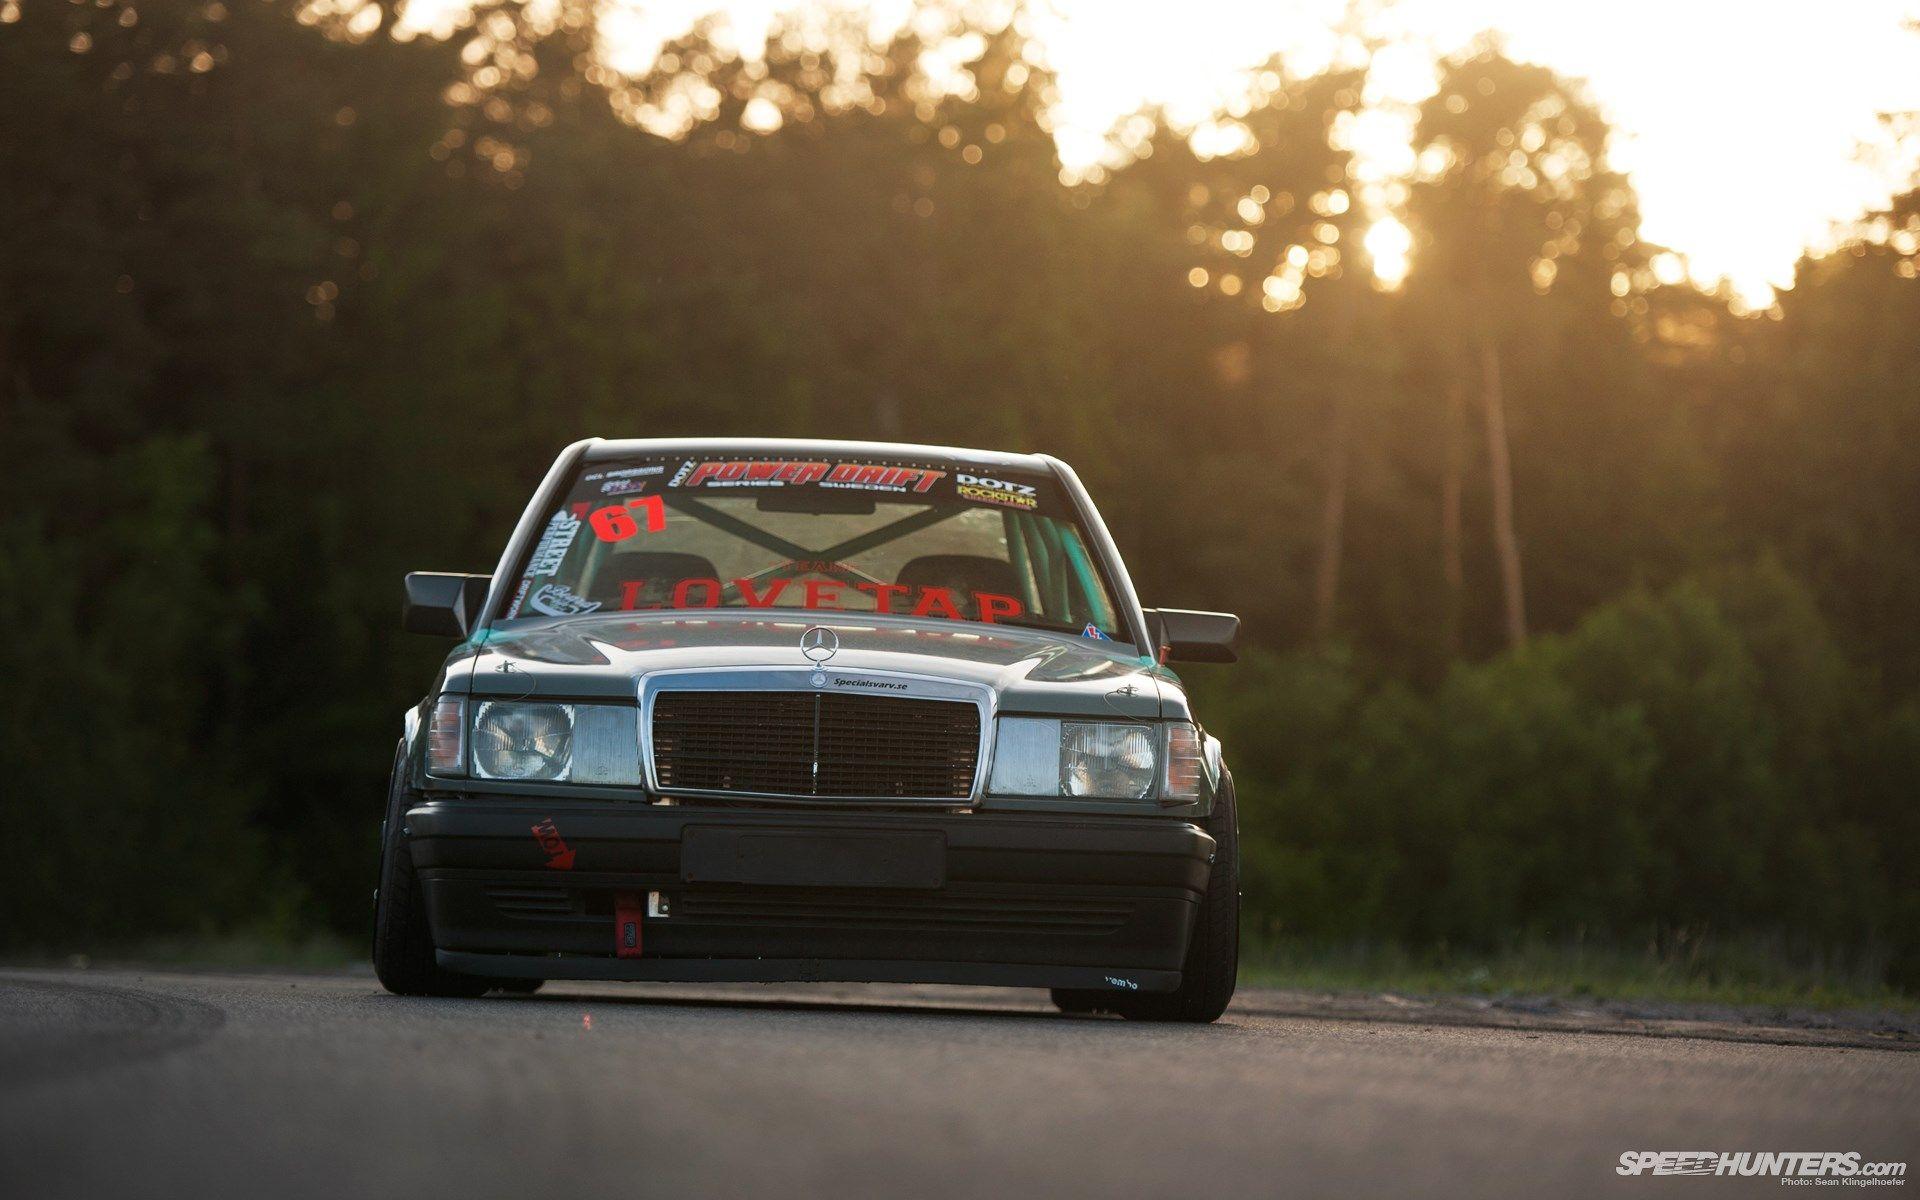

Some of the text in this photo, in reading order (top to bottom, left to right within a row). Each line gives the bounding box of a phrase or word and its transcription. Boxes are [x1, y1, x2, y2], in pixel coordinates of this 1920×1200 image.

[685, 461, 832, 487] POWER
[826, 463, 947, 493] DRIFT
[956, 473, 1037, 497] DOTZ
[588, 495, 667, 543] 67
[619, 577, 1026, 625] LOVETAP
[832, 677, 909, 691] Specialsvarv.se
